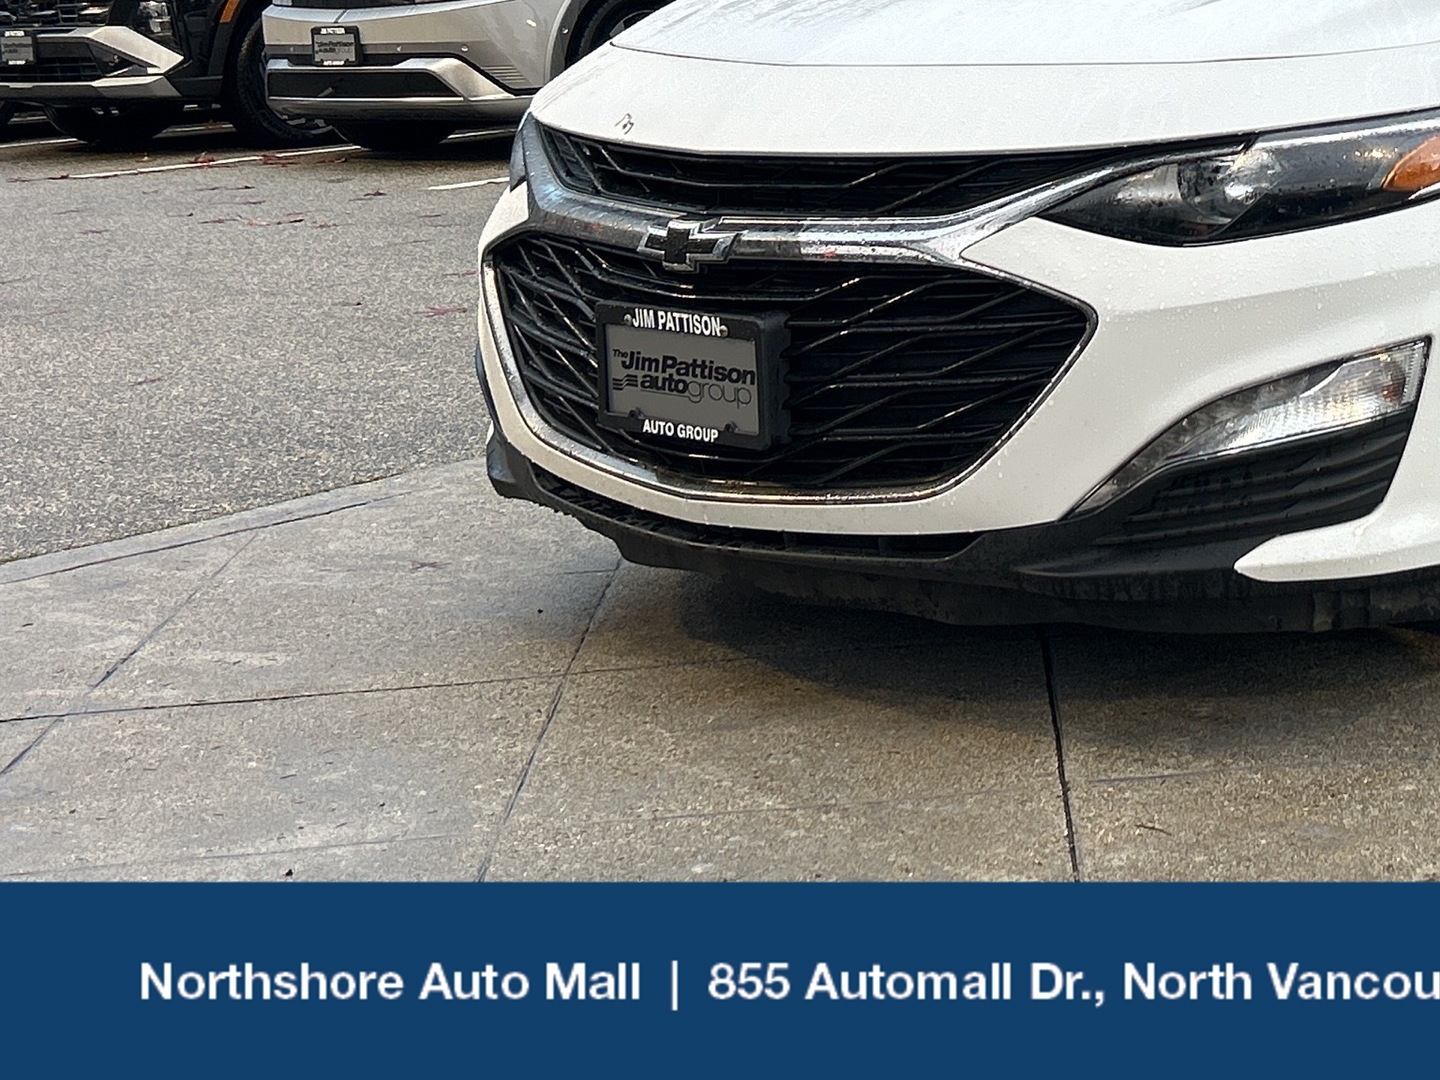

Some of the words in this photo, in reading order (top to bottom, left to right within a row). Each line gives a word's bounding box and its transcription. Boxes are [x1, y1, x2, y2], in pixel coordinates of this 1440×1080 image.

[632, 308, 655, 329] JIM
[657, 310, 721, 337] PATTISON
[612, 348, 629, 359] The
[642, 419, 675, 437] AUTO
[676, 423, 719, 443] GROUP
